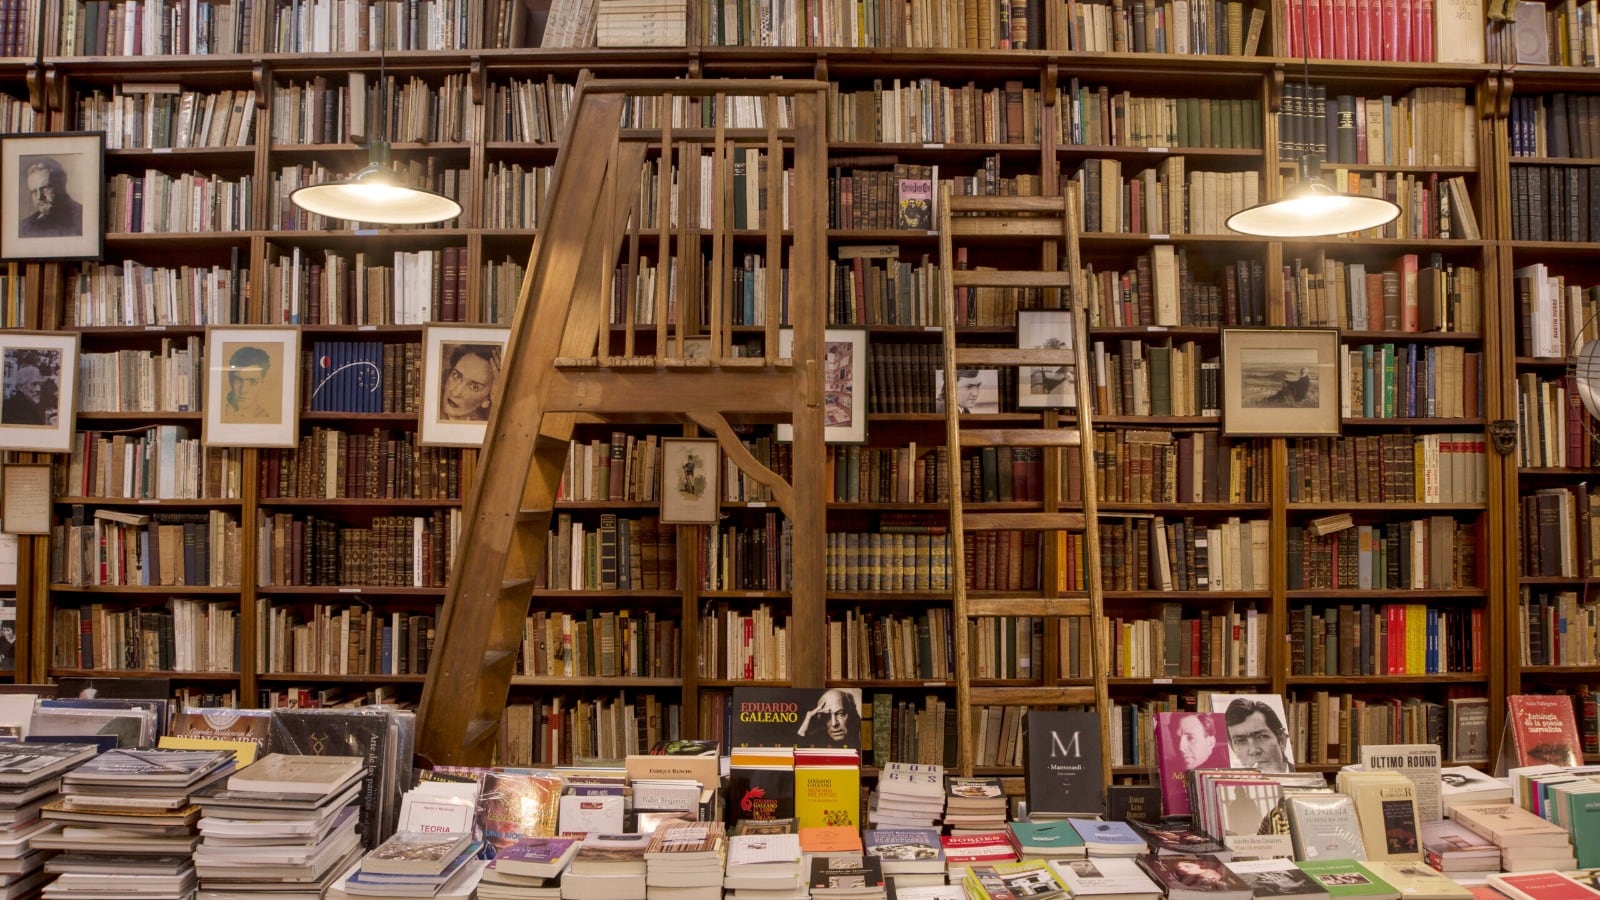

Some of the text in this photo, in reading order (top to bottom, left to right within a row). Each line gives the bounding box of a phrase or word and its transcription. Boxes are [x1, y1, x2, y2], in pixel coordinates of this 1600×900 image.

[741, 702, 798, 713] EDUARDO
[740, 712, 798, 722] GALEANO
[370, 733, 379, 751] Arte
[1051, 731, 1081, 757] M
[369, 753, 377, 763] de
[1371, 756, 1437, 768] ULTIMO ROUND
[368, 765, 377, 777] las
[366, 778, 375, 810] pampas
